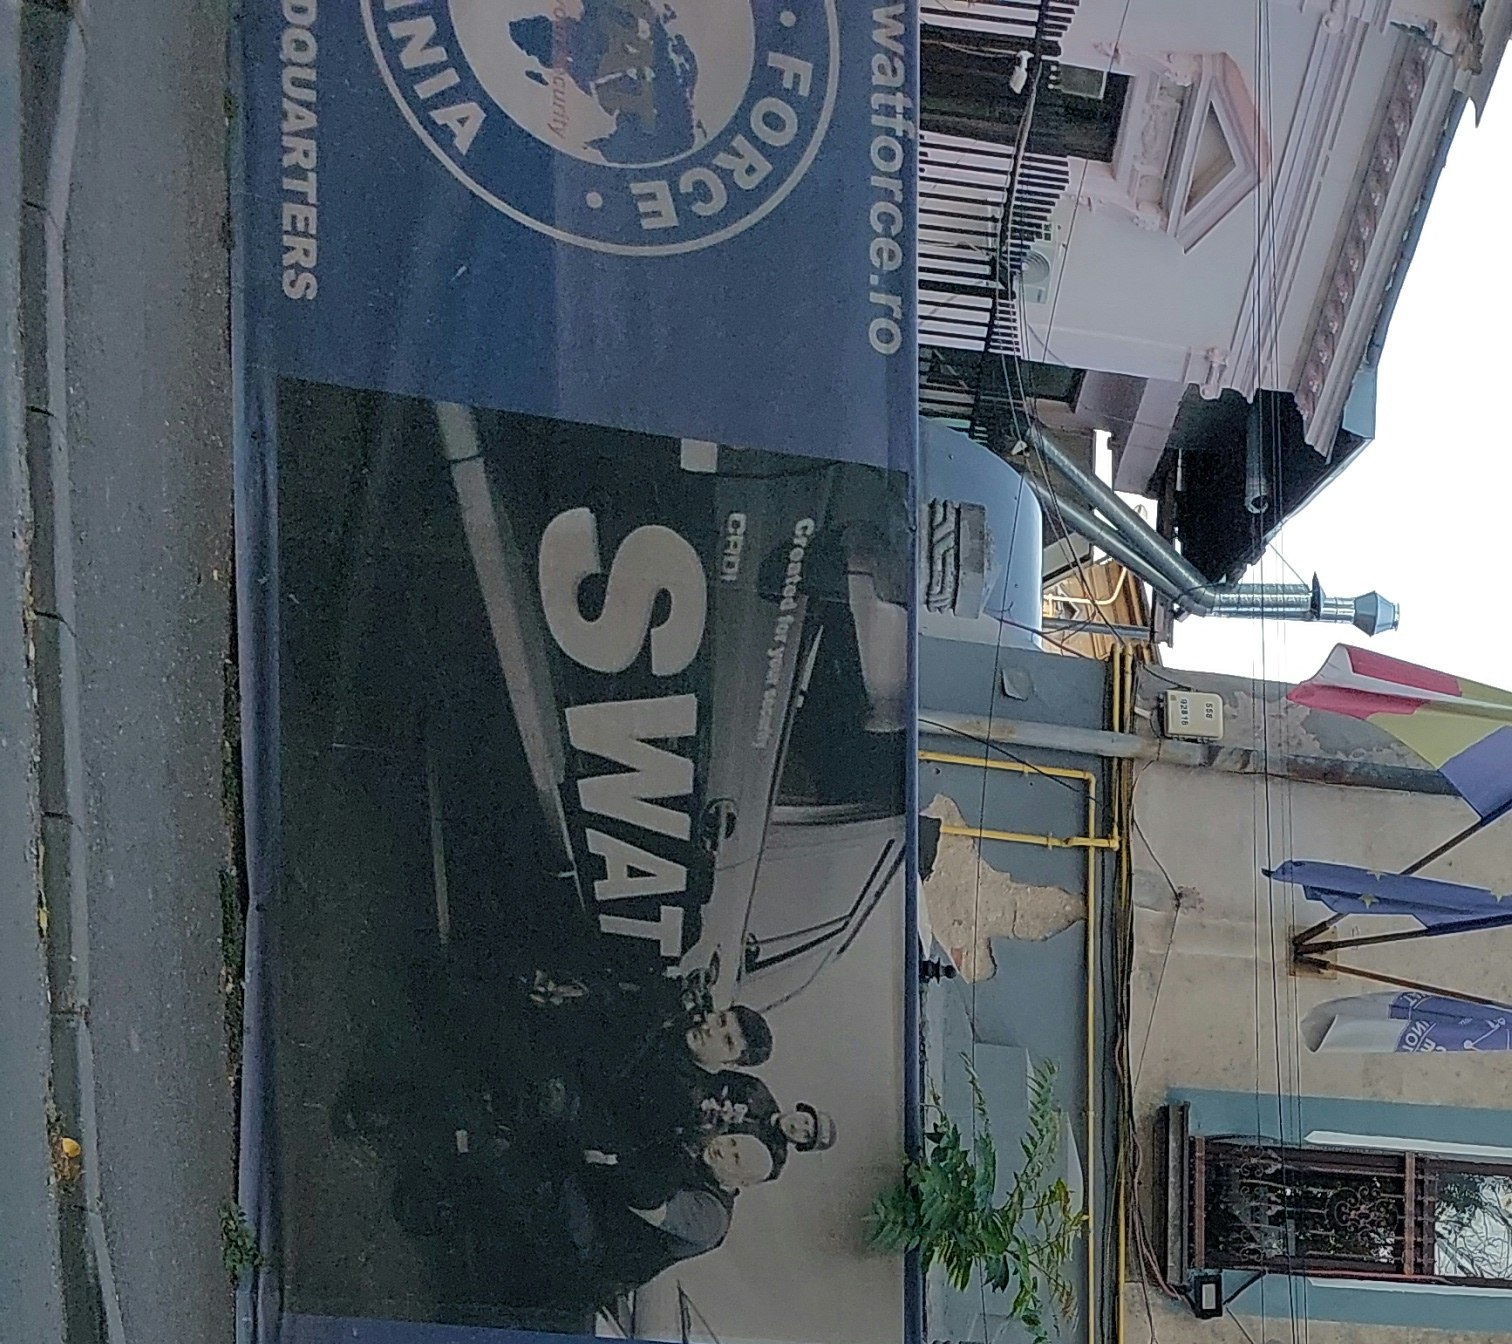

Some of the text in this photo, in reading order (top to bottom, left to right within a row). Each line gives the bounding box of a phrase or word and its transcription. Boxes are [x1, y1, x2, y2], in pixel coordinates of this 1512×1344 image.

[383, 0, 487, 156] NIA
[628, 51, 813, 230] FORCE
[869, 3, 914, 355] watforce.ro
[773, 615, 794, 643] for
[779, 517, 815, 610] Created
[537, 507, 708, 957] SWAT
